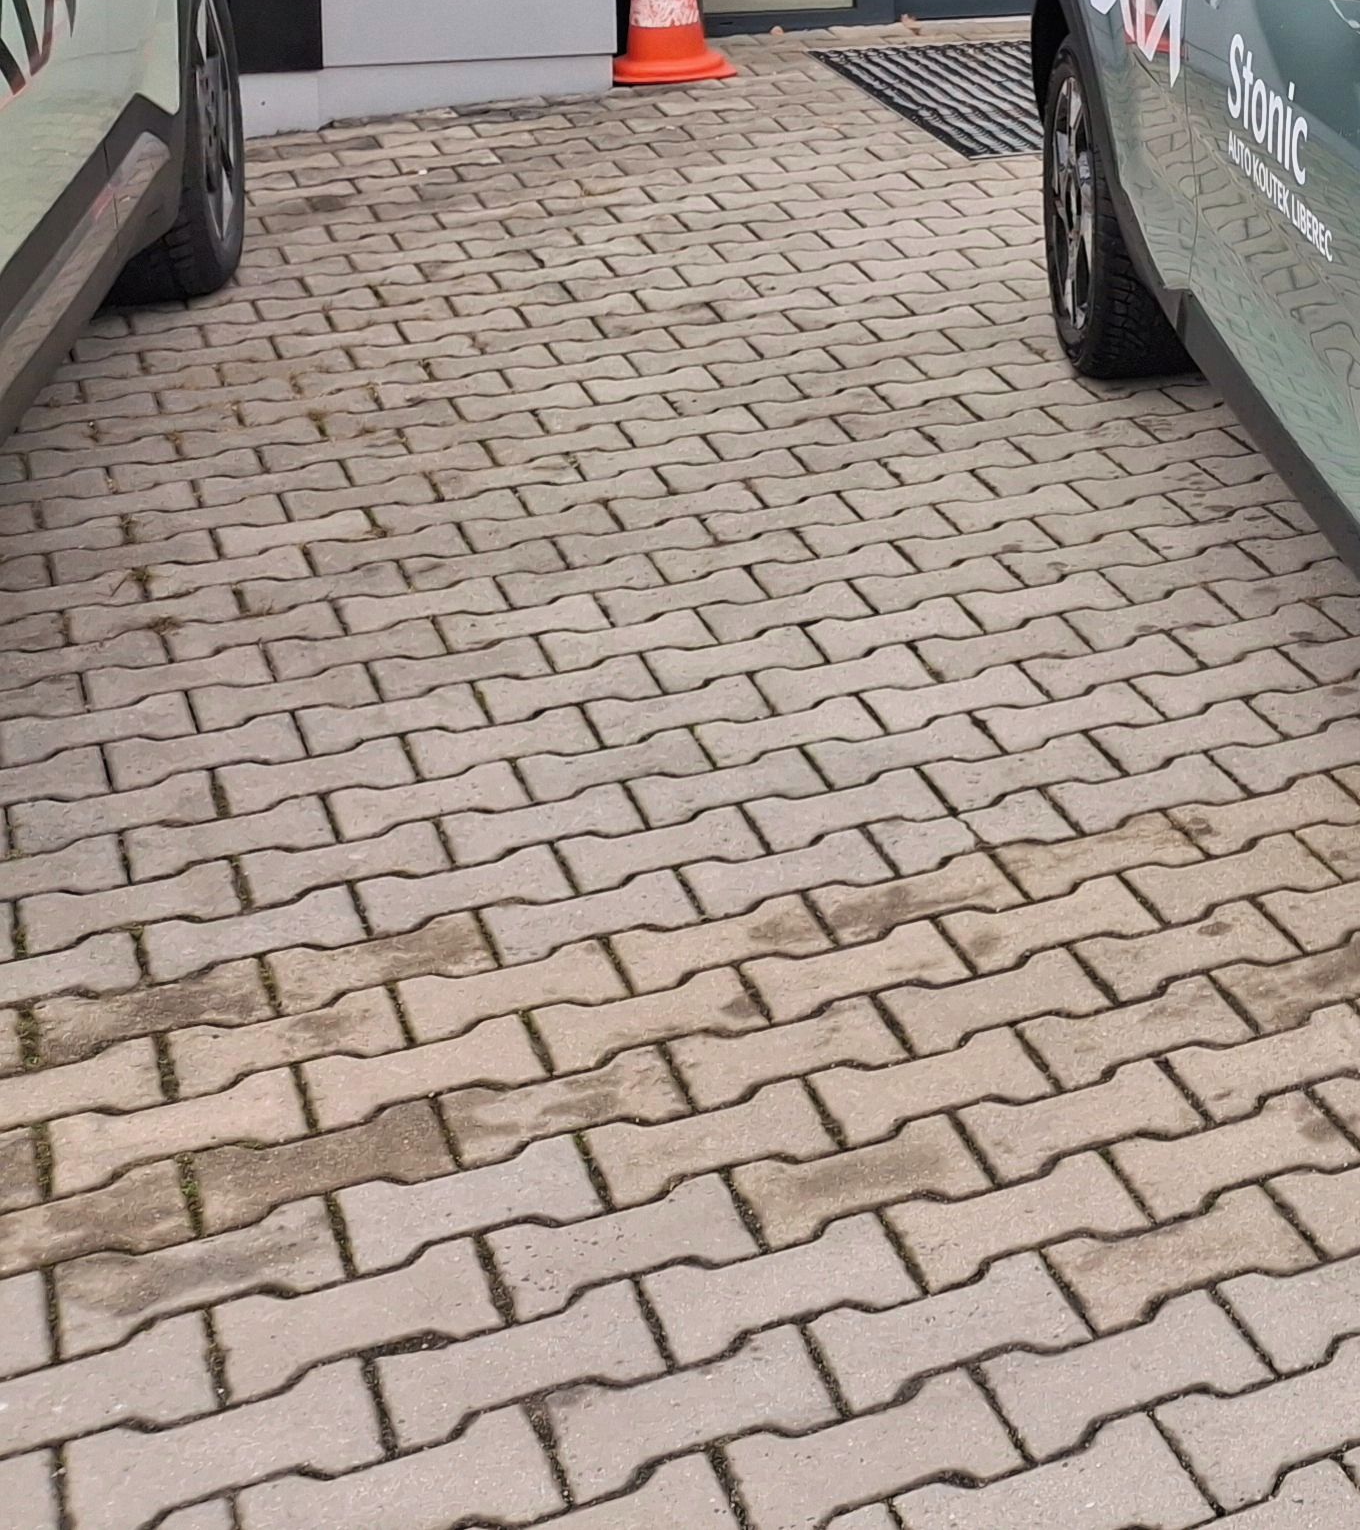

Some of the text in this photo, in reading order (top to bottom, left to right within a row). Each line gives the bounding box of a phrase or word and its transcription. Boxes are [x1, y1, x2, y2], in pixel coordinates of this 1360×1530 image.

[1226, 33, 1308, 186] Stonic
[1228, 129, 1333, 263] AUTO KOUTEK LIBEREC
